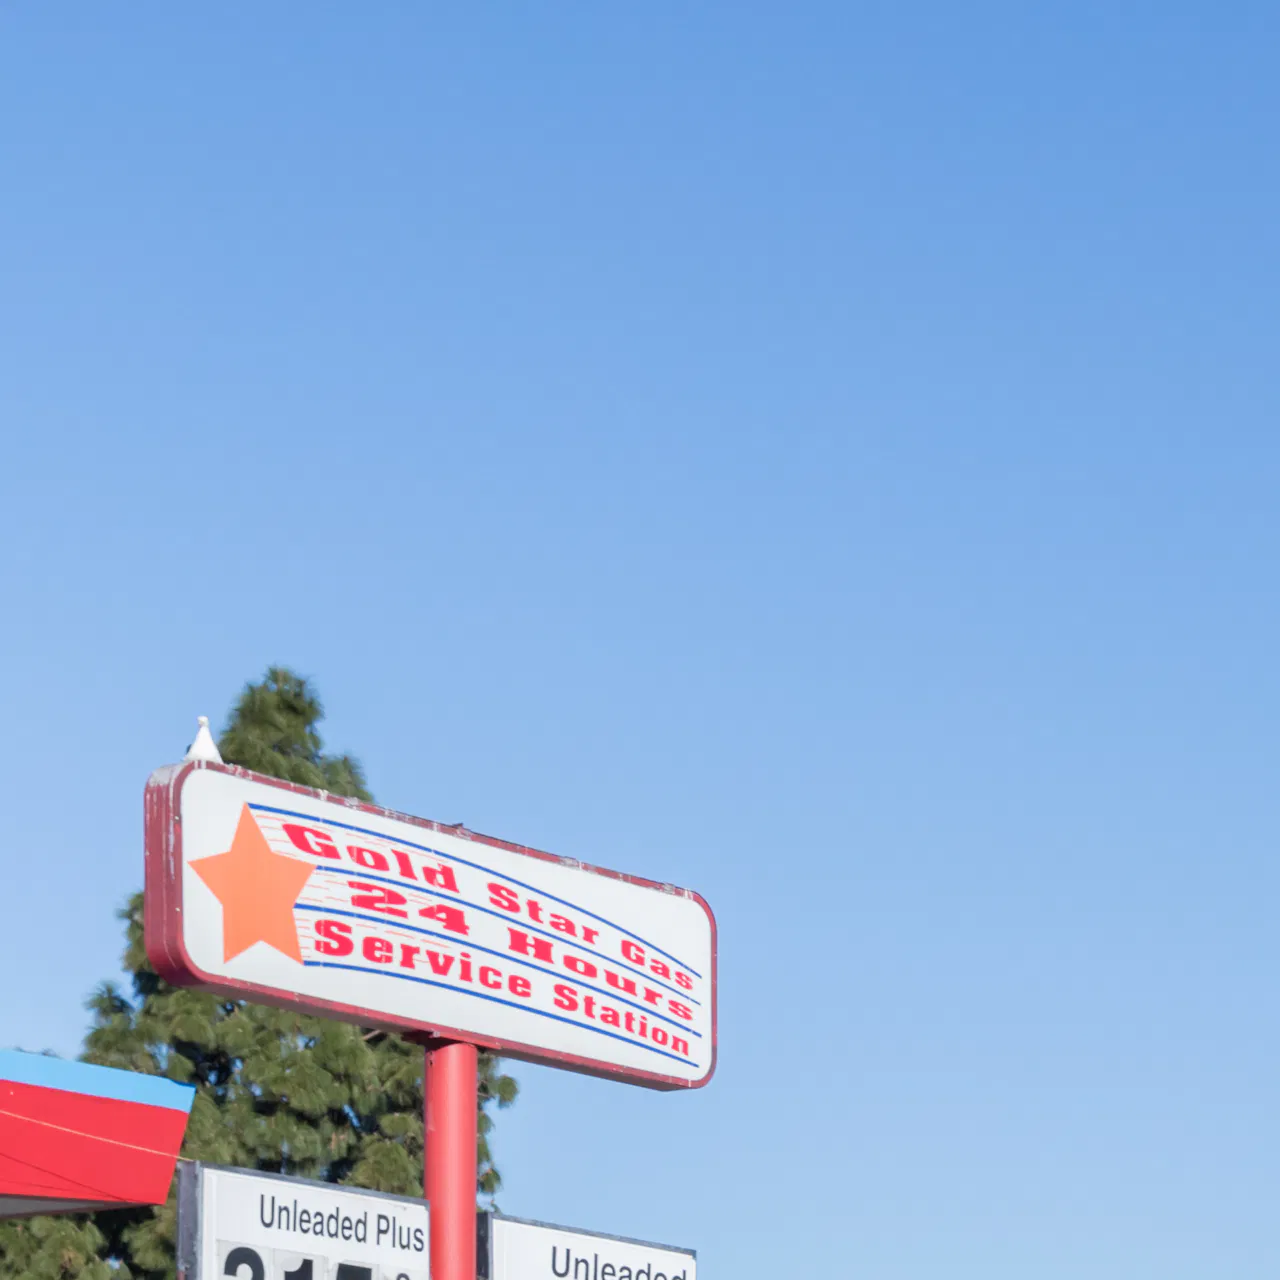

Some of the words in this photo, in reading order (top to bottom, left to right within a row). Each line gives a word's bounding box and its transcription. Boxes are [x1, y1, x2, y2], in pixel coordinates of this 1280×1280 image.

[282, 823, 460, 894] Gold
[487, 882, 599, 945] Star
[621, 939, 694, 991] Gas
[348, 880, 470, 936] 24
[508, 927, 694, 1021] Hours
[314, 919, 532, 998] Service
[554, 983, 690, 1056] Station
[259, 1194, 368, 1244] Unleaded
[376, 1213, 425, 1252] Plus
